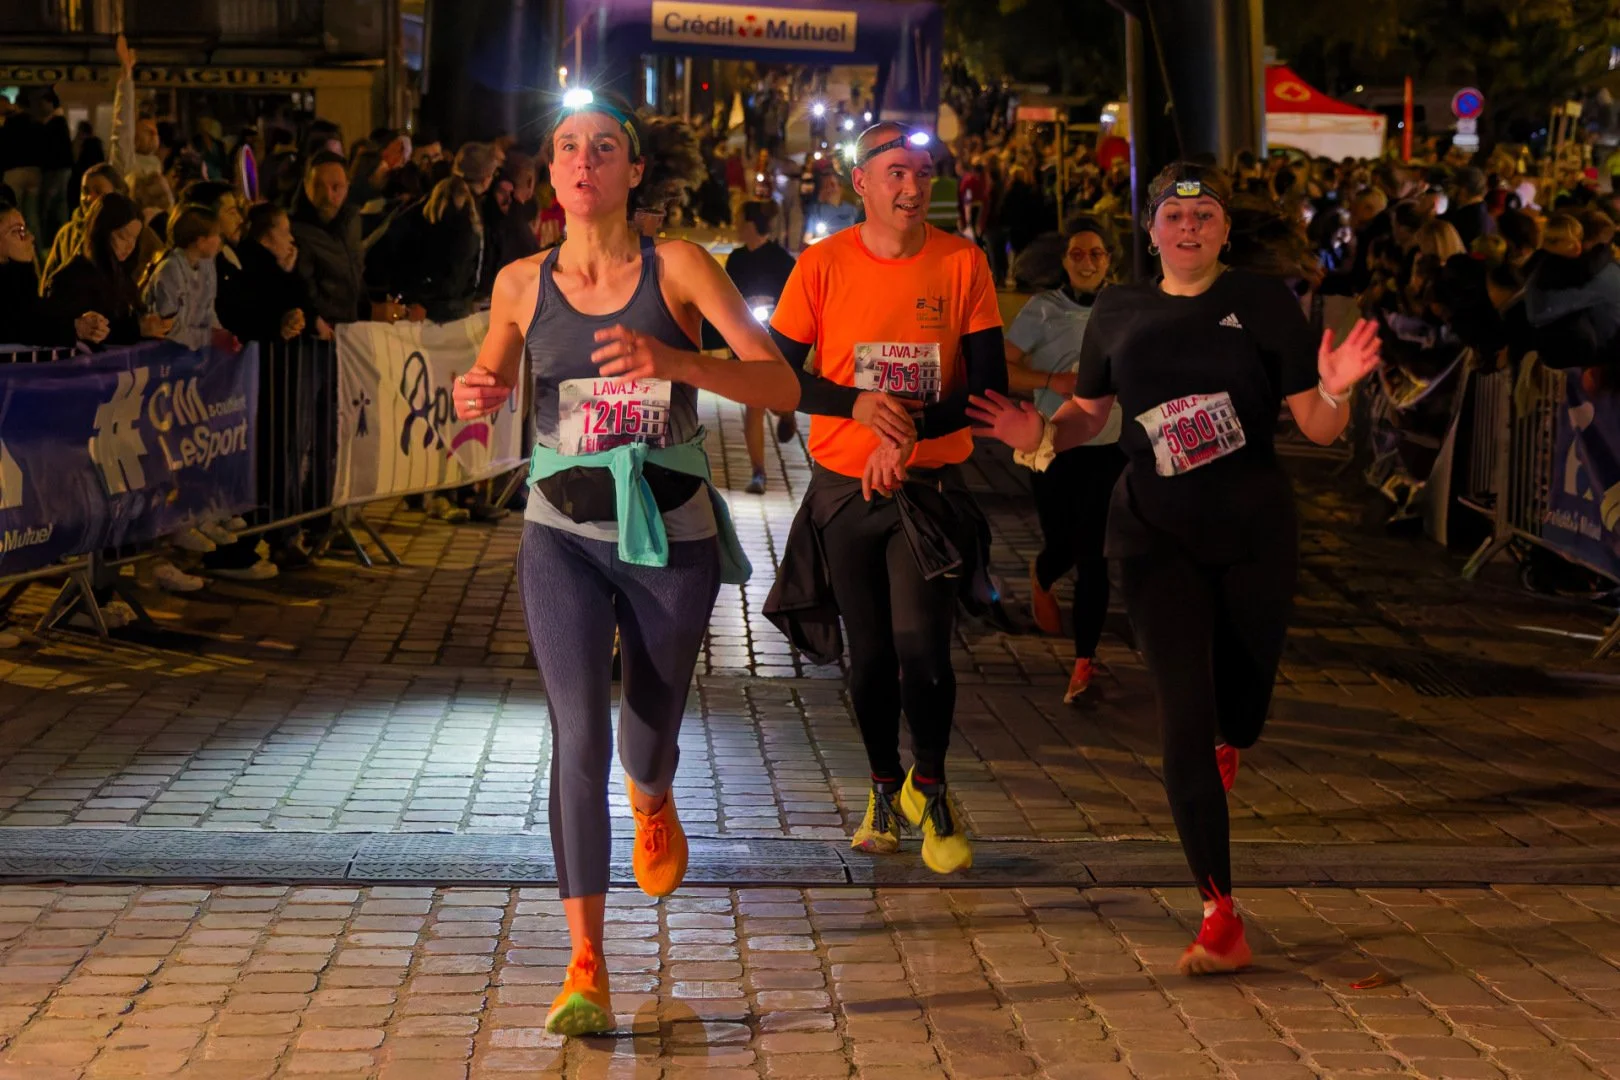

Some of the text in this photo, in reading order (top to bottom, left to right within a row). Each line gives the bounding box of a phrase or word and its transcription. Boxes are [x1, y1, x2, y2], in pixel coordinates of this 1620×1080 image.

[664, 12, 846, 42] Crédit Mutuel
[877, 361, 920, 392] 753
[148, 377, 209, 431] CM
[581, 400, 641, 434] 1215
[158, 417, 247, 471] LeSport
[1163, 409, 1216, 455] 560
[4, 522, 53, 552] Mutuel
